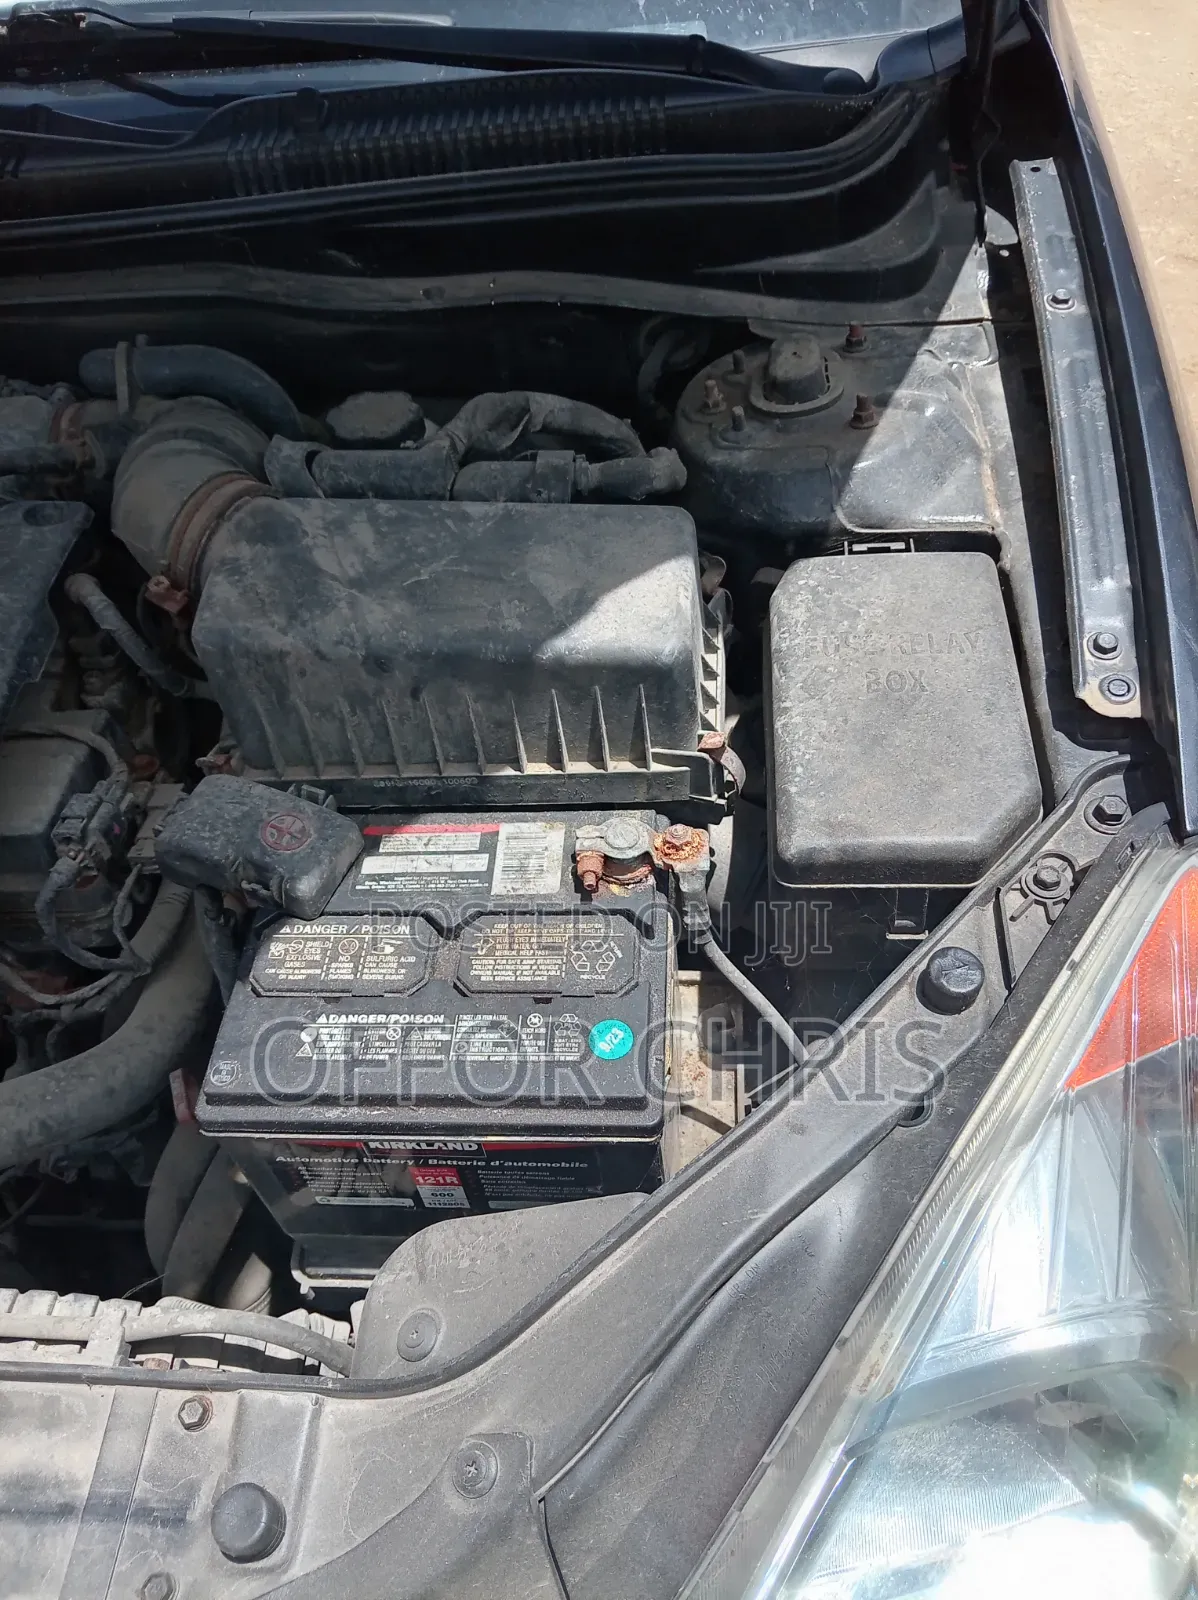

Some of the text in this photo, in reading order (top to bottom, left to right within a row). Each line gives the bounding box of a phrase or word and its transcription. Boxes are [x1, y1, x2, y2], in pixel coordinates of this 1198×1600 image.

[865, 669, 929, 693] BOX
[294, 924, 347, 934] DANGER
[361, 924, 410, 934] POISON
[328, 1014, 444, 1024] DANGER/POISON
[369, 1142, 478, 1150] KIRKLAND
[363, 1156, 415, 1165] battery
